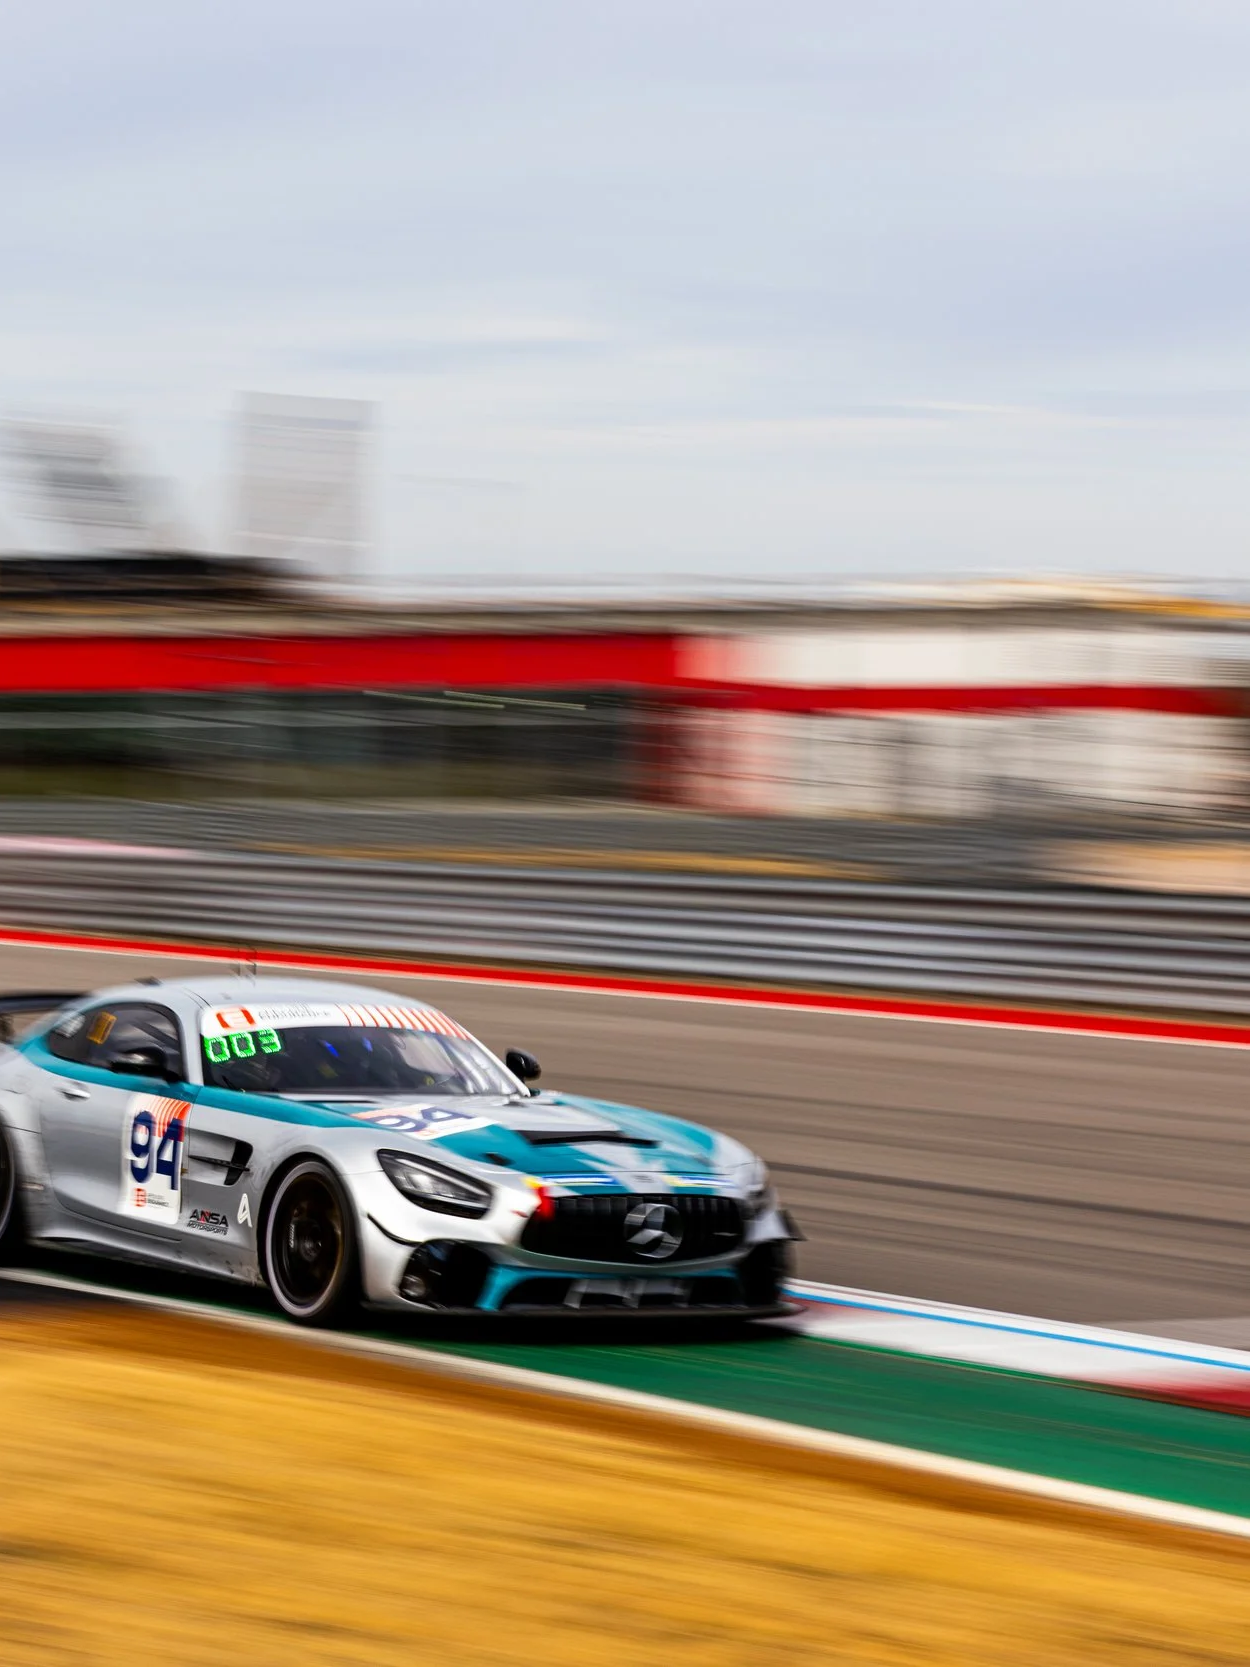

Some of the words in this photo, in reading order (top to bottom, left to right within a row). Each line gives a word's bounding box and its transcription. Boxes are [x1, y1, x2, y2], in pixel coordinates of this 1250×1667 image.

[204, 1028, 281, 1062] 003
[131, 1111, 184, 1190] 94
[187, 1221, 228, 1235] MOTORSPORTS
[190, 1208, 228, 1227] ANSA
